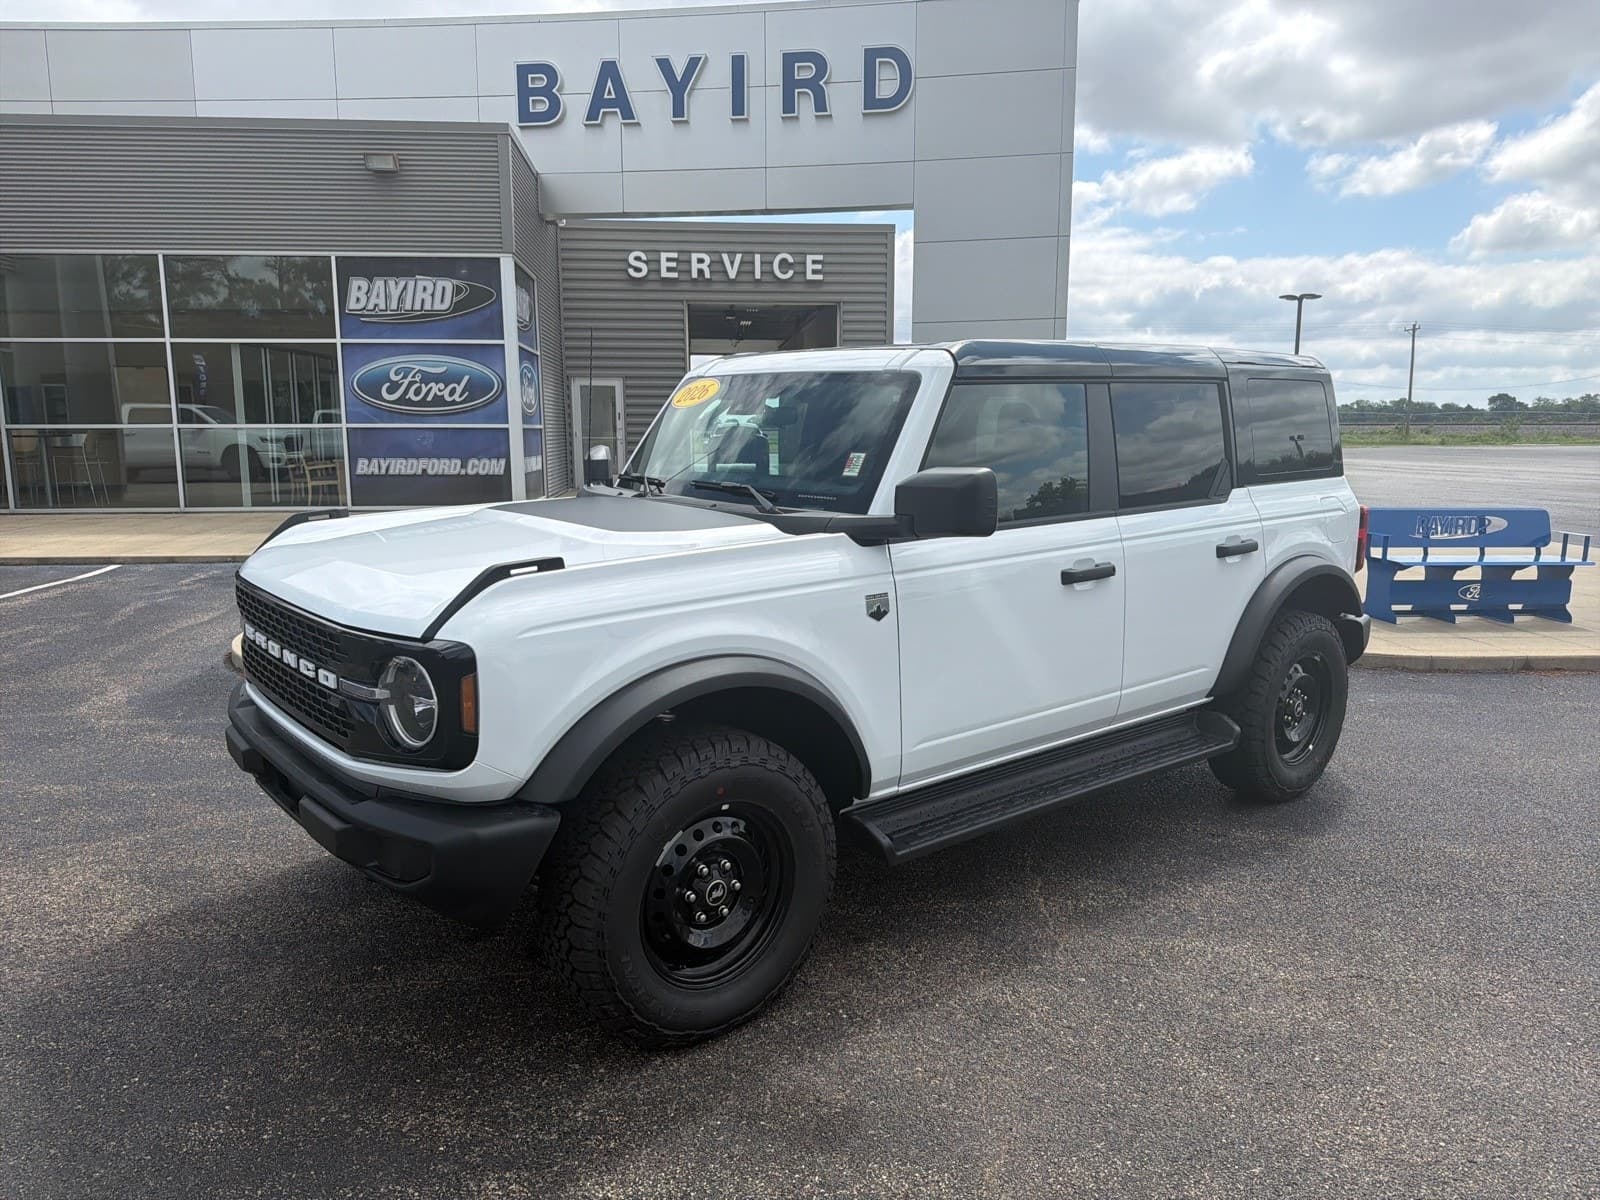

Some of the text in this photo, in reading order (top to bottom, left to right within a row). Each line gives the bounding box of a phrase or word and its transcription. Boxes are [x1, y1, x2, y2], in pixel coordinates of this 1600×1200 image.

[514, 44, 915, 127] BAYIRD
[627, 250, 825, 281] SERVICE
[346, 276, 455, 314] BAYIRD
[381, 364, 470, 402] Ford
[355, 457, 506, 476] BAYIRDFORD.COM
[244, 623, 338, 690] BRONCO
